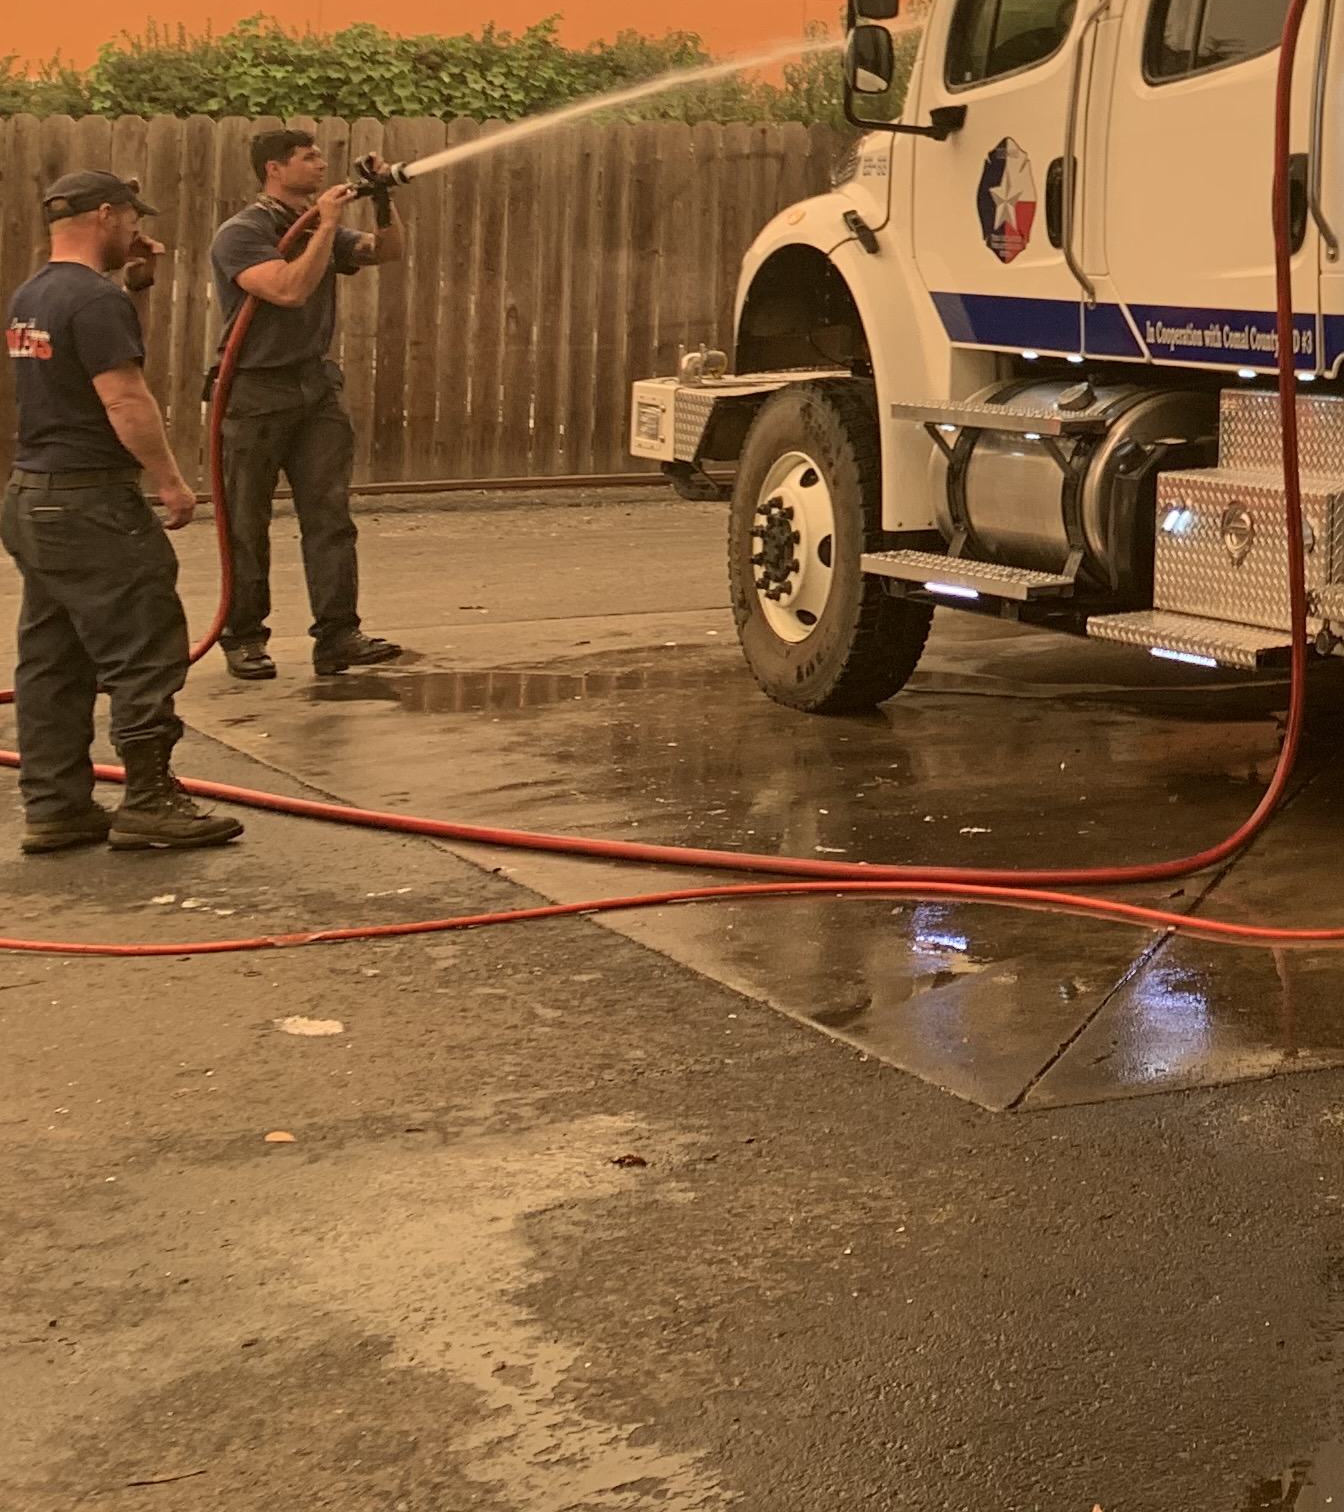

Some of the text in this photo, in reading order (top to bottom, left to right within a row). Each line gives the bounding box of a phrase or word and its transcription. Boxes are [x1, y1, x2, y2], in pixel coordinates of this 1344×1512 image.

[1146, 320, 1156, 344] In
[1155, 320, 1203, 352] Cooperation
[1203, 321, 1222, 348] with
[1222, 324, 1249, 350] Comal
[1301, 329, 1313, 355] #3
